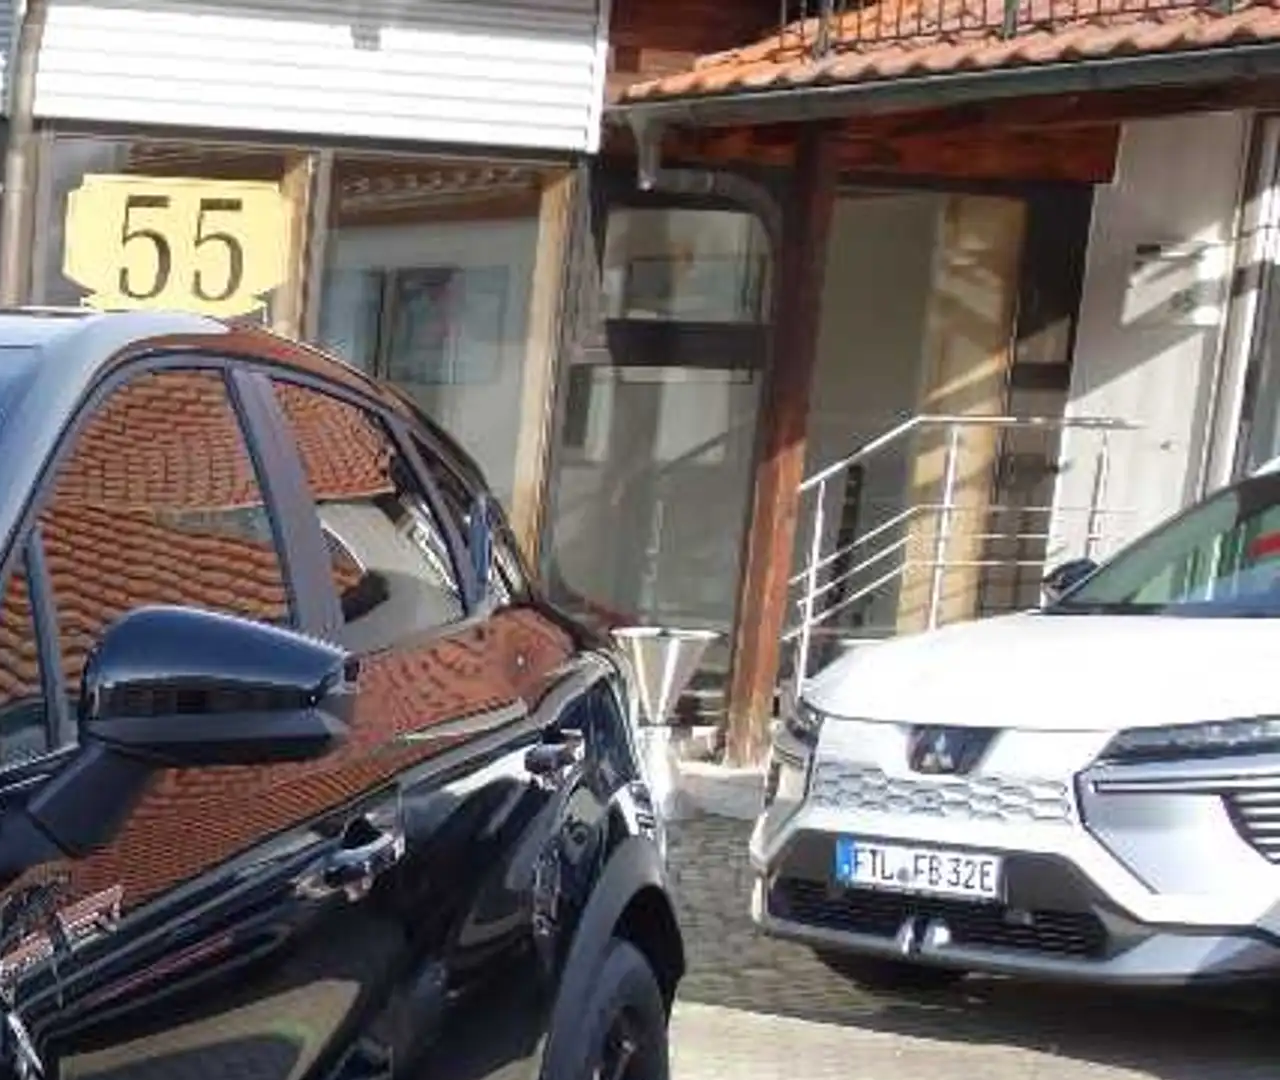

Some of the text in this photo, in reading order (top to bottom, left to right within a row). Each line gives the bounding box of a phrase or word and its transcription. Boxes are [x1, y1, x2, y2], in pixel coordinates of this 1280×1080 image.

[118, 194, 244, 302] 55
[853, 848, 895, 881] FTL
[946, 857, 995, 893] 32E
